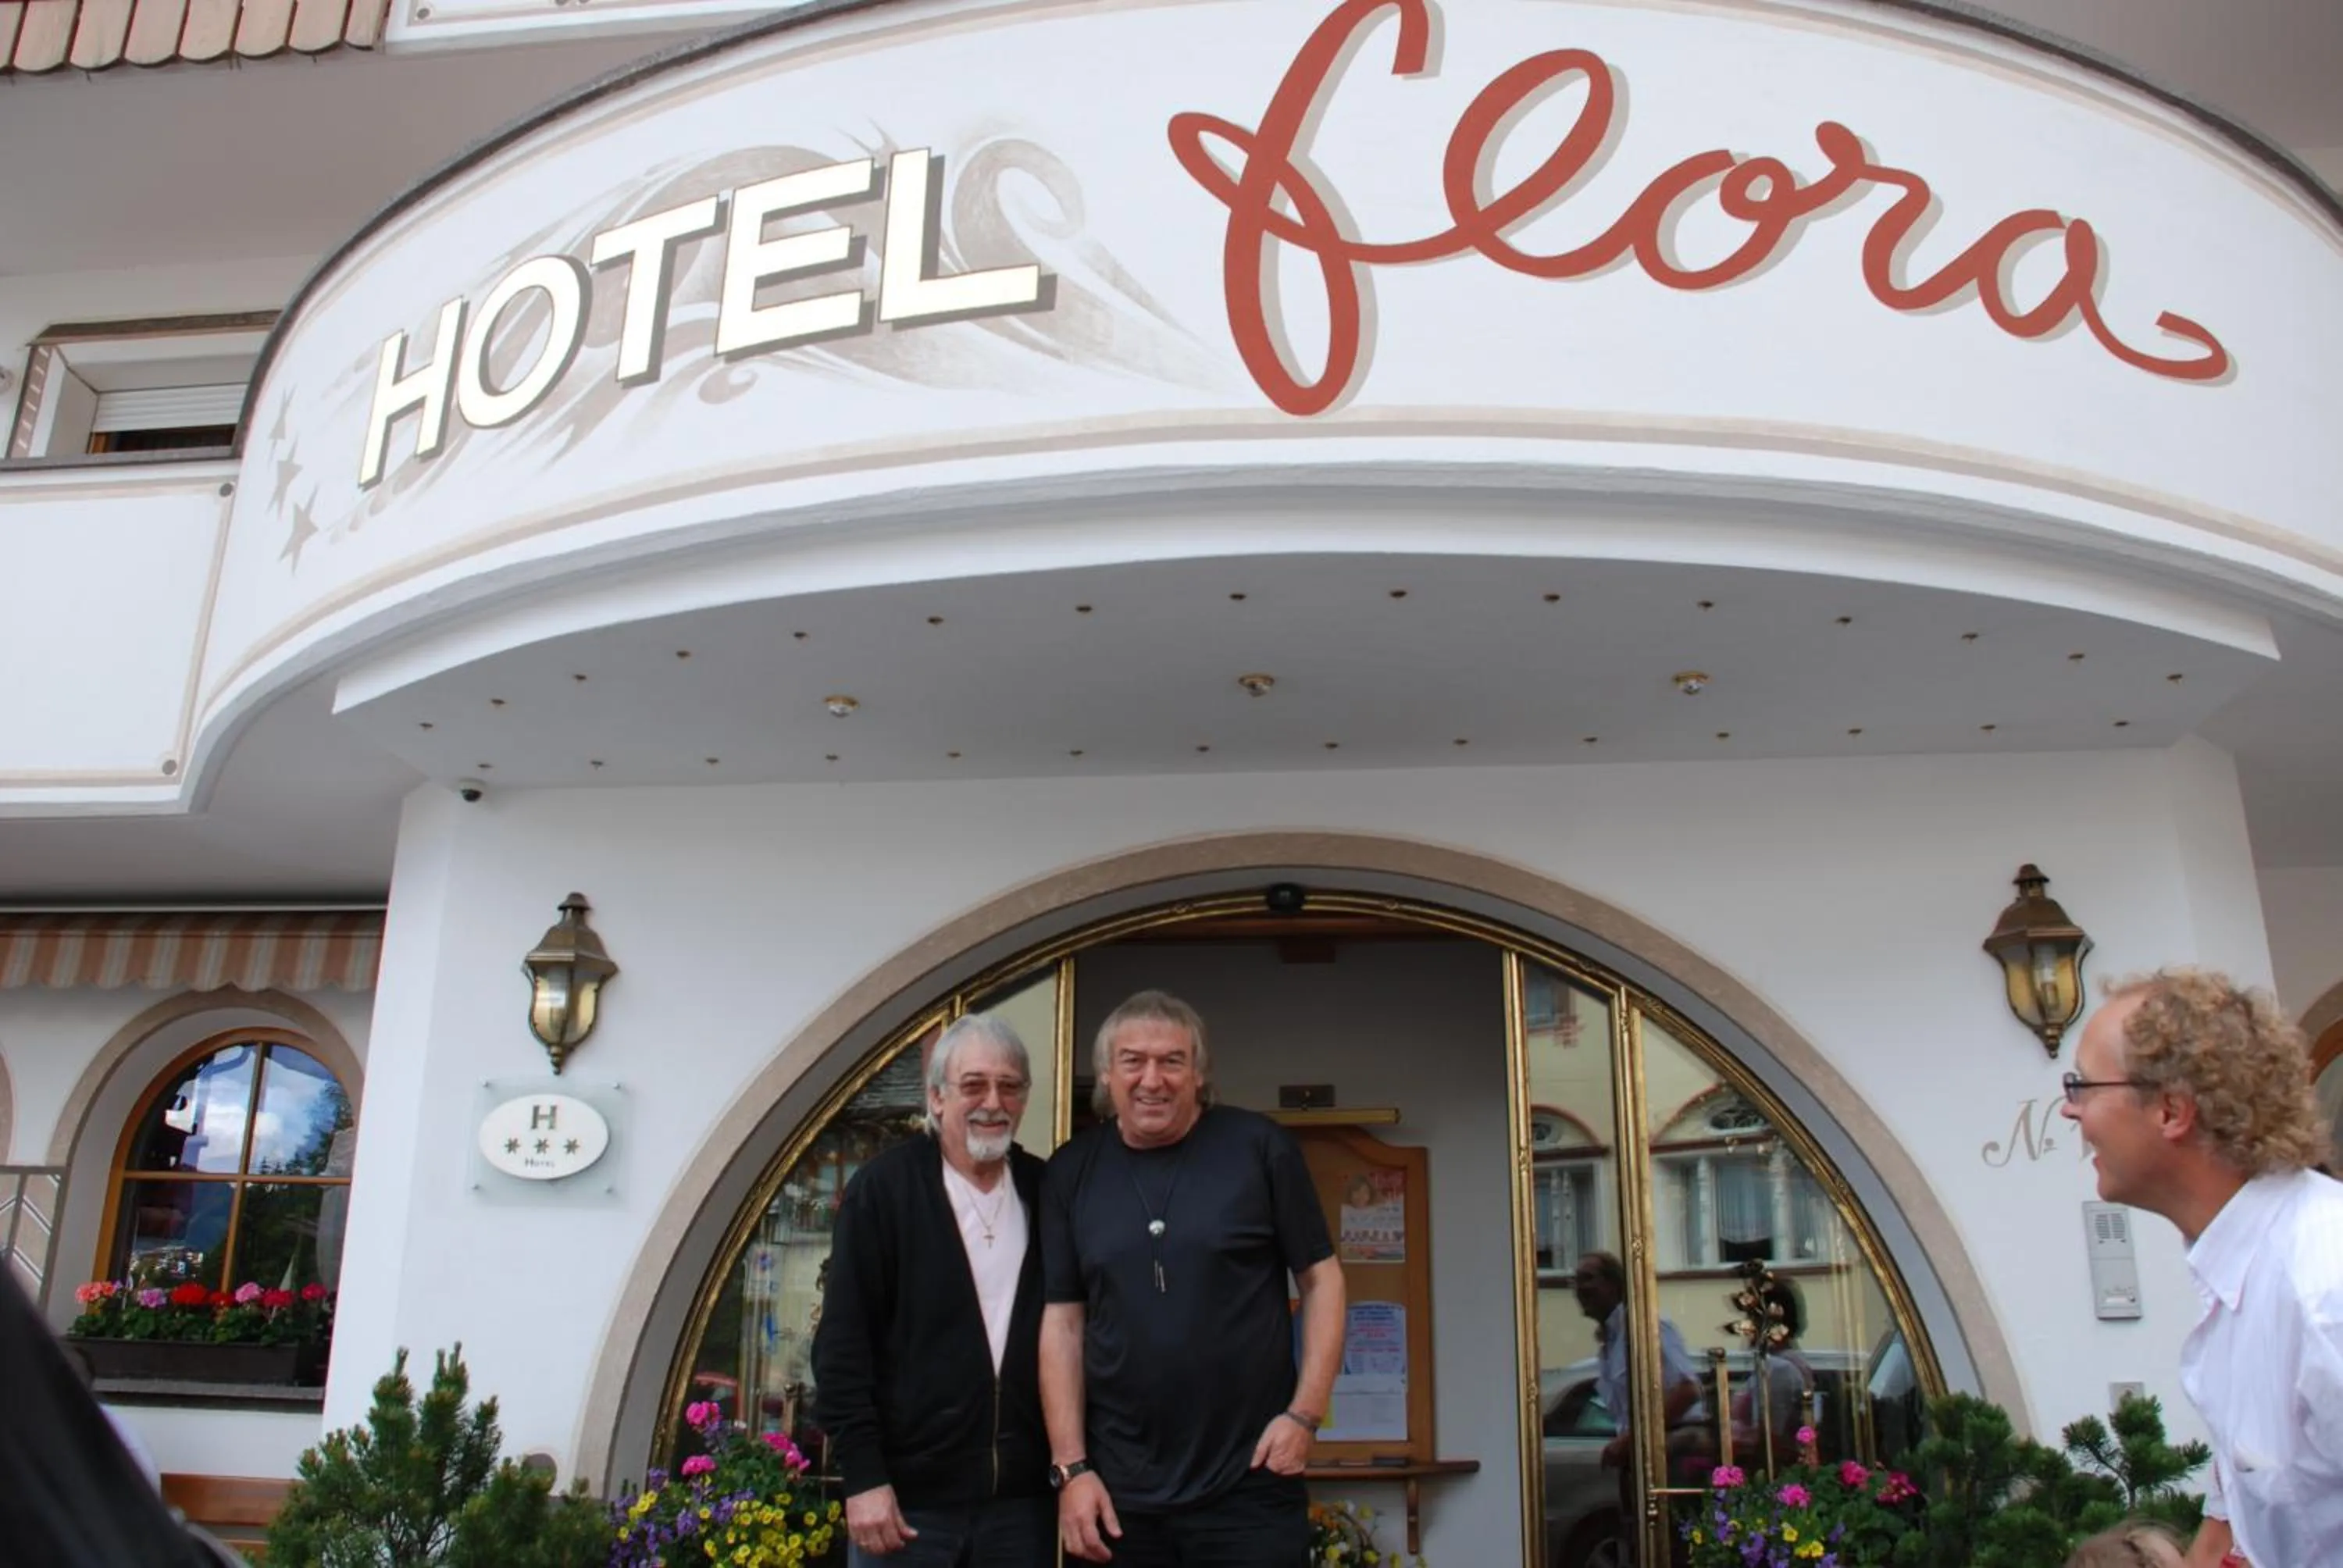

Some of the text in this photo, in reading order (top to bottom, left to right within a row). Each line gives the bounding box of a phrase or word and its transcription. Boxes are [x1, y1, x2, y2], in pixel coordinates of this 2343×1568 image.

[358, 0, 2231, 490] HOTEL flora
[530, 1104, 558, 1130] H
